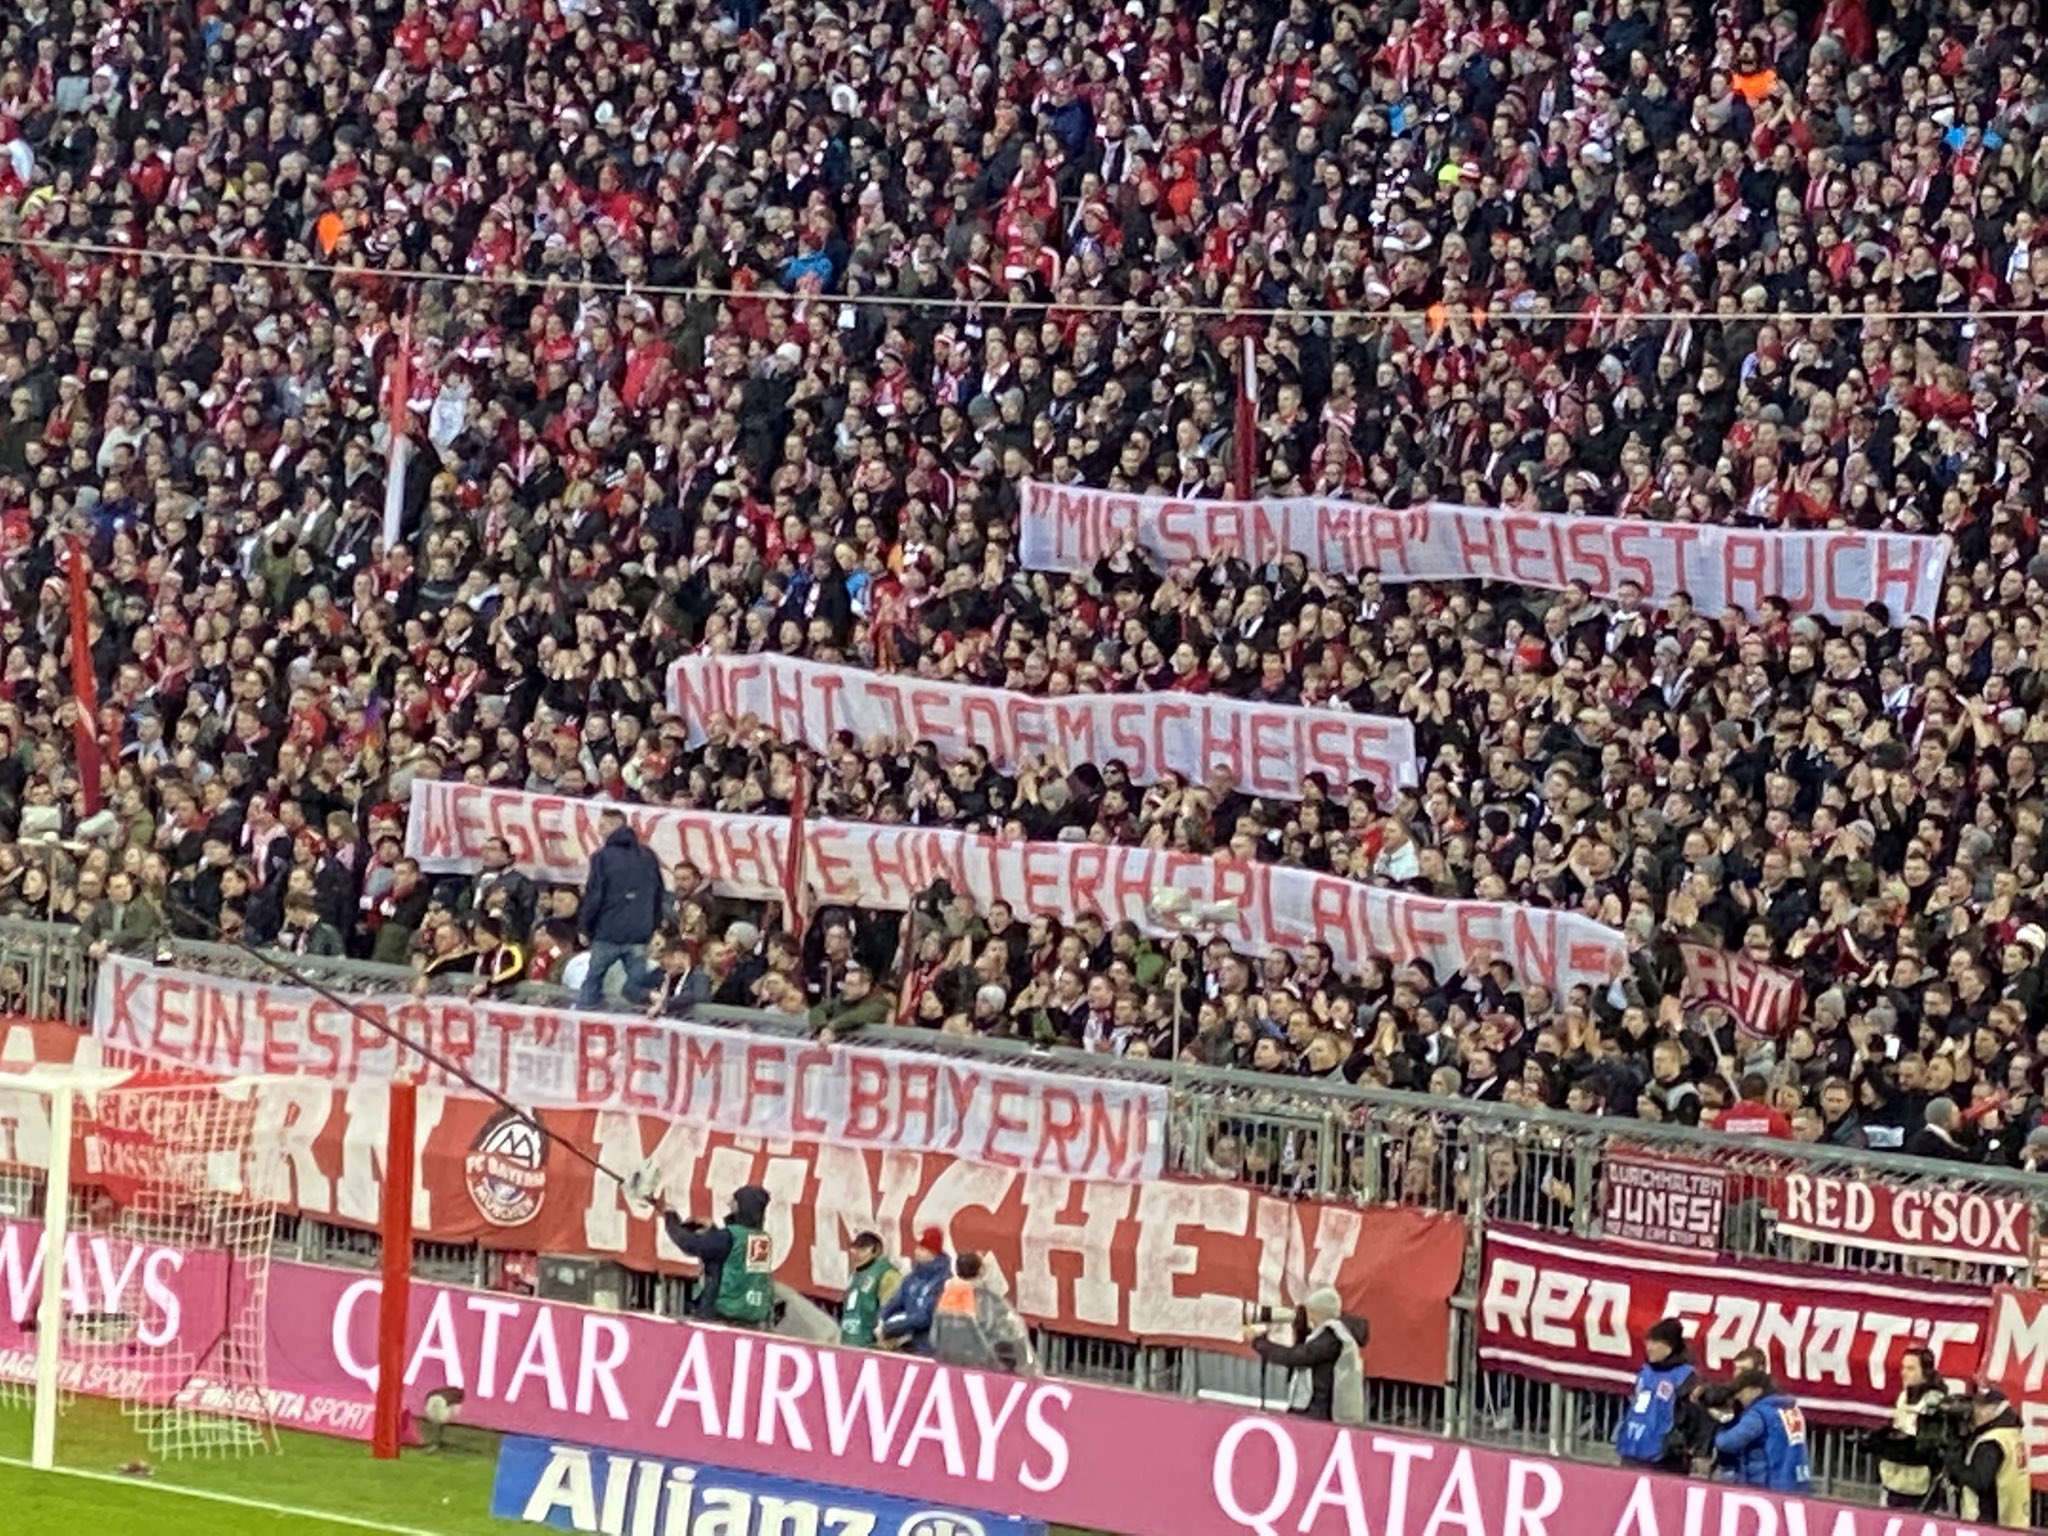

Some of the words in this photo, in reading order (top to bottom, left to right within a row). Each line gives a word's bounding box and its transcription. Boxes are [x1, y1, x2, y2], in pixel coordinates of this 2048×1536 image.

[1160, 501, 1291, 570] SAN
[1454, 511, 1698, 598] HEISST
[1723, 535, 1921, 613] AUCH
[677, 663, 843, 746] NICHT
[864, 682, 1095, 768] JEDEM
[1110, 702, 1394, 800] SCHEISS
[108, 964, 244, 1068] KEIN
[575, 1021, 722, 1122] BEIM
[741, 1044, 833, 1133] FC
[844, 1056, 1148, 1177] BAYERN!
[1607, 1184, 1721, 1235] JUNGS!
[1784, 1173, 1875, 1233] RED
[1891, 1185, 2024, 1252] G'SOX
[305, 1396, 376, 1432] SPORT
[332, 1279, 631, 1420] QATAR
[656, 1336, 1072, 1492] AIRWAYS
[1627, 1421, 1647, 1441] TV
[522, 1446, 877, 1536] Allianz
